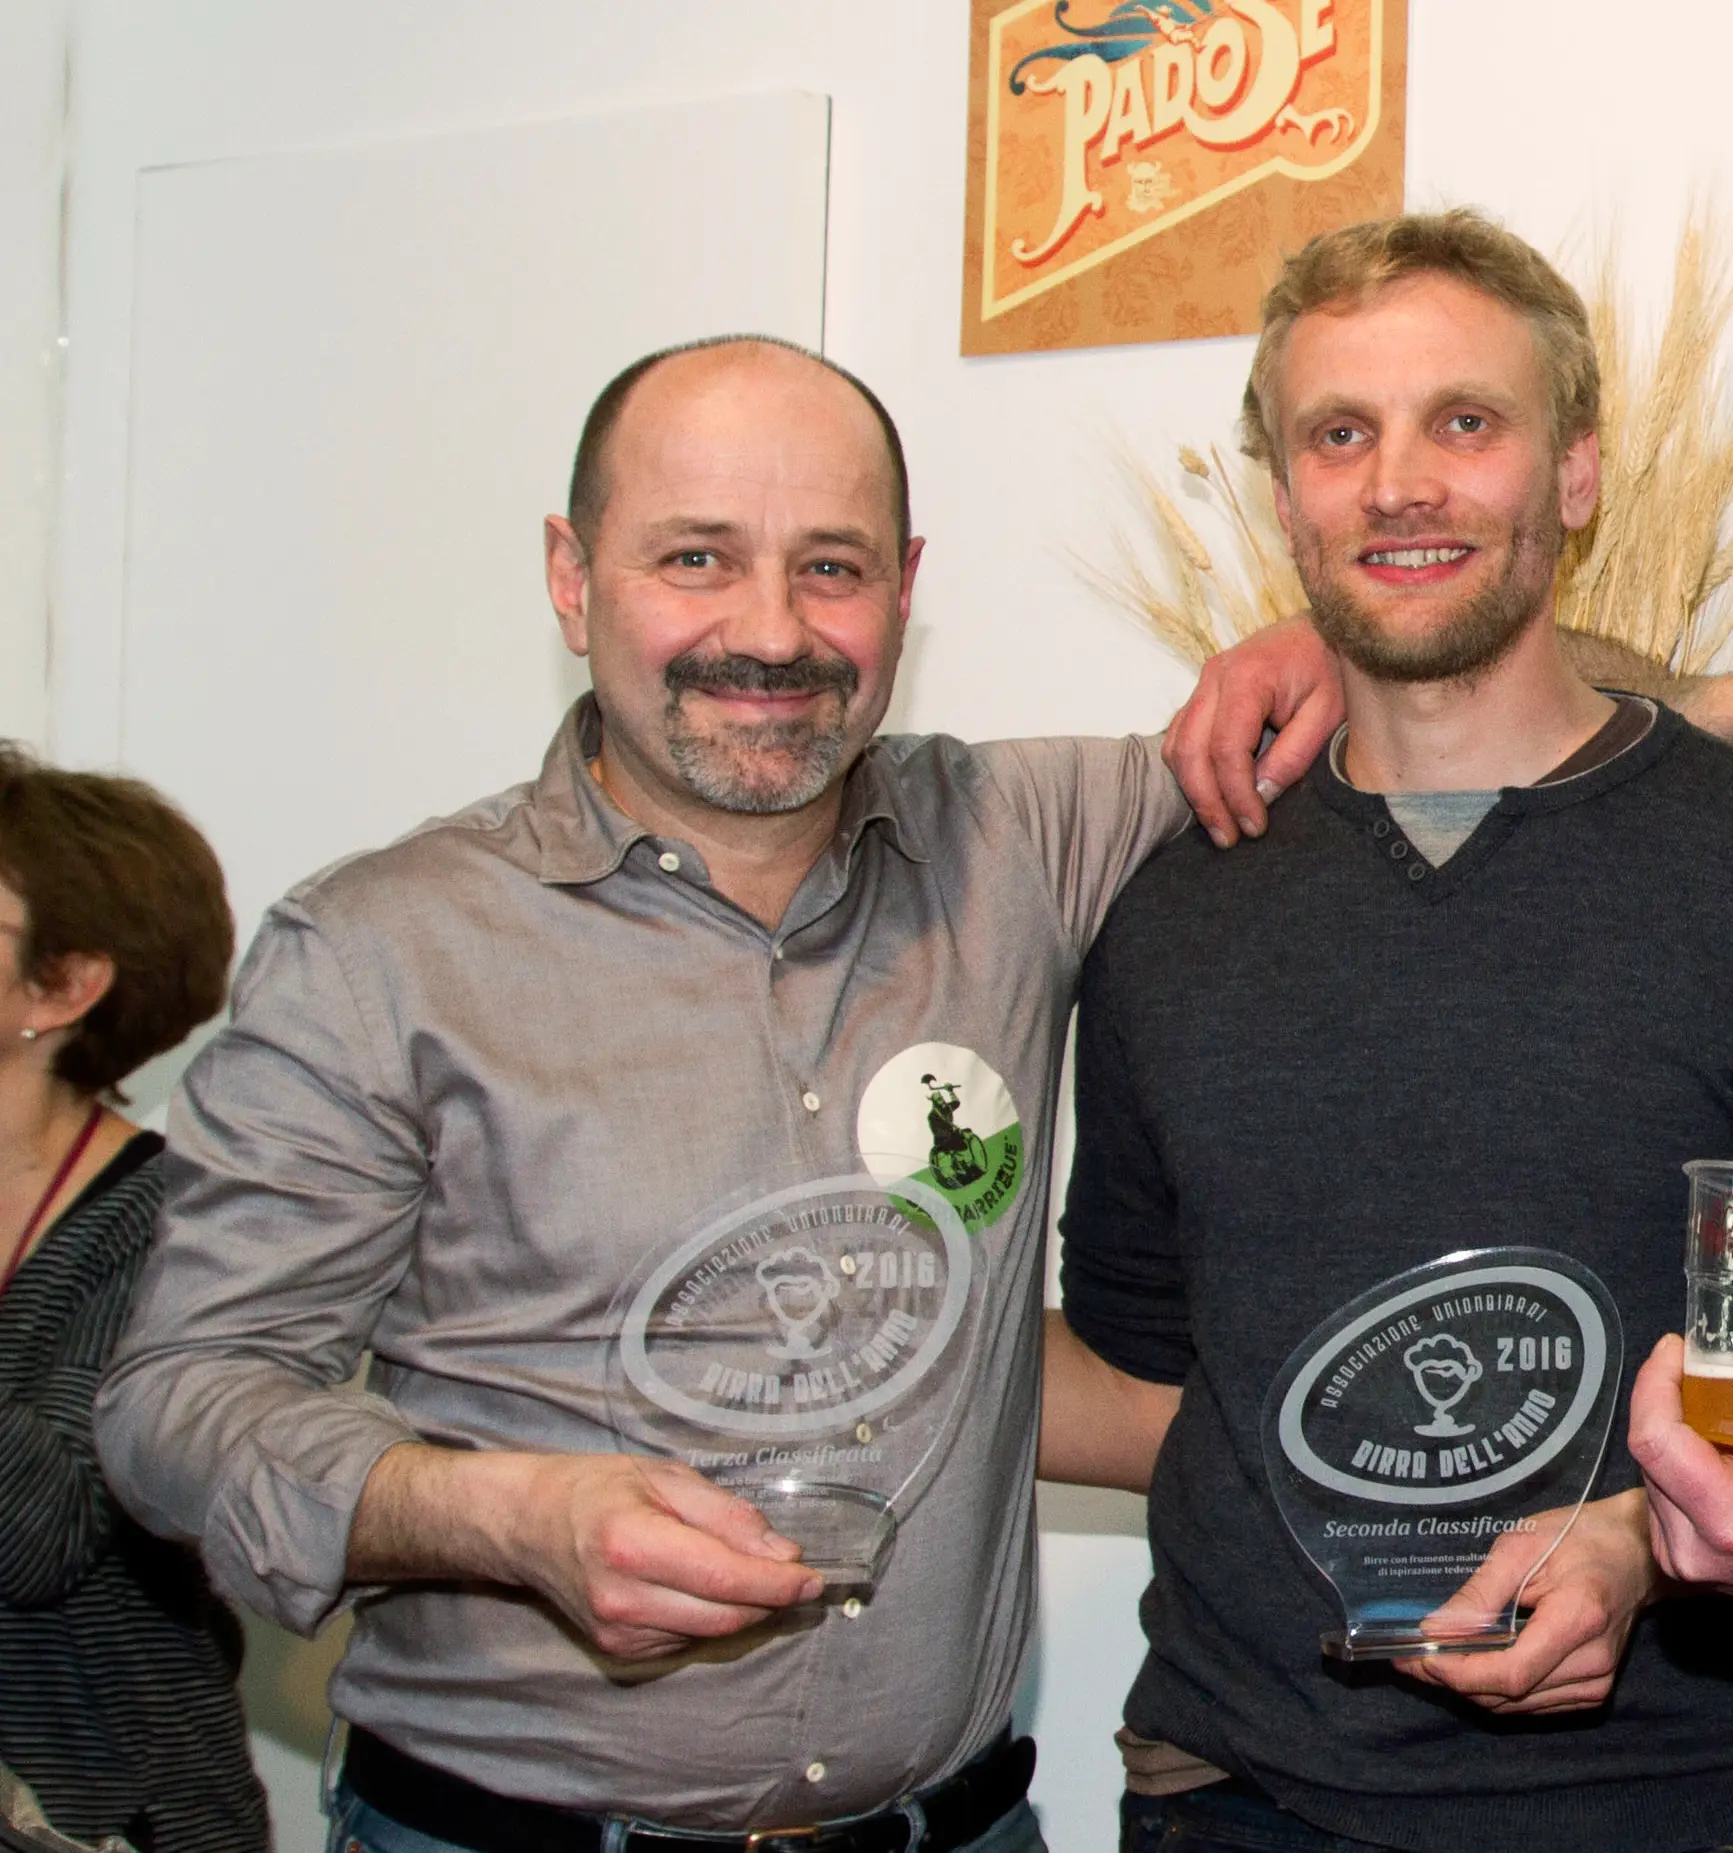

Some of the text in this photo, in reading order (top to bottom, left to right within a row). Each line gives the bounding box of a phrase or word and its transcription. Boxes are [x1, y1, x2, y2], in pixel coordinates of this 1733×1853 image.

[855, 1251, 935, 1290] 2016
[699, 1308, 917, 1404] BIRRA DELL'ANNO
[1320, 1294, 1548, 1409] ASSOCIAZIONE UNIONBIRRAI
[1496, 1336, 1572, 1372] 2016
[1351, 1388, 1556, 1479] BIRRA DELL'ANNO
[688, 1449, 748, 1468] Terza
[1323, 1514, 1537, 1539] Seconda Classificata
[1364, 1555, 1389, 1565] Birre
[1390, 1556, 1408, 1564] con
[1409, 1554, 1455, 1564] frumento
[1378, 1567, 1388, 1576] di
[1390, 1565, 1443, 1577] ispirazione
